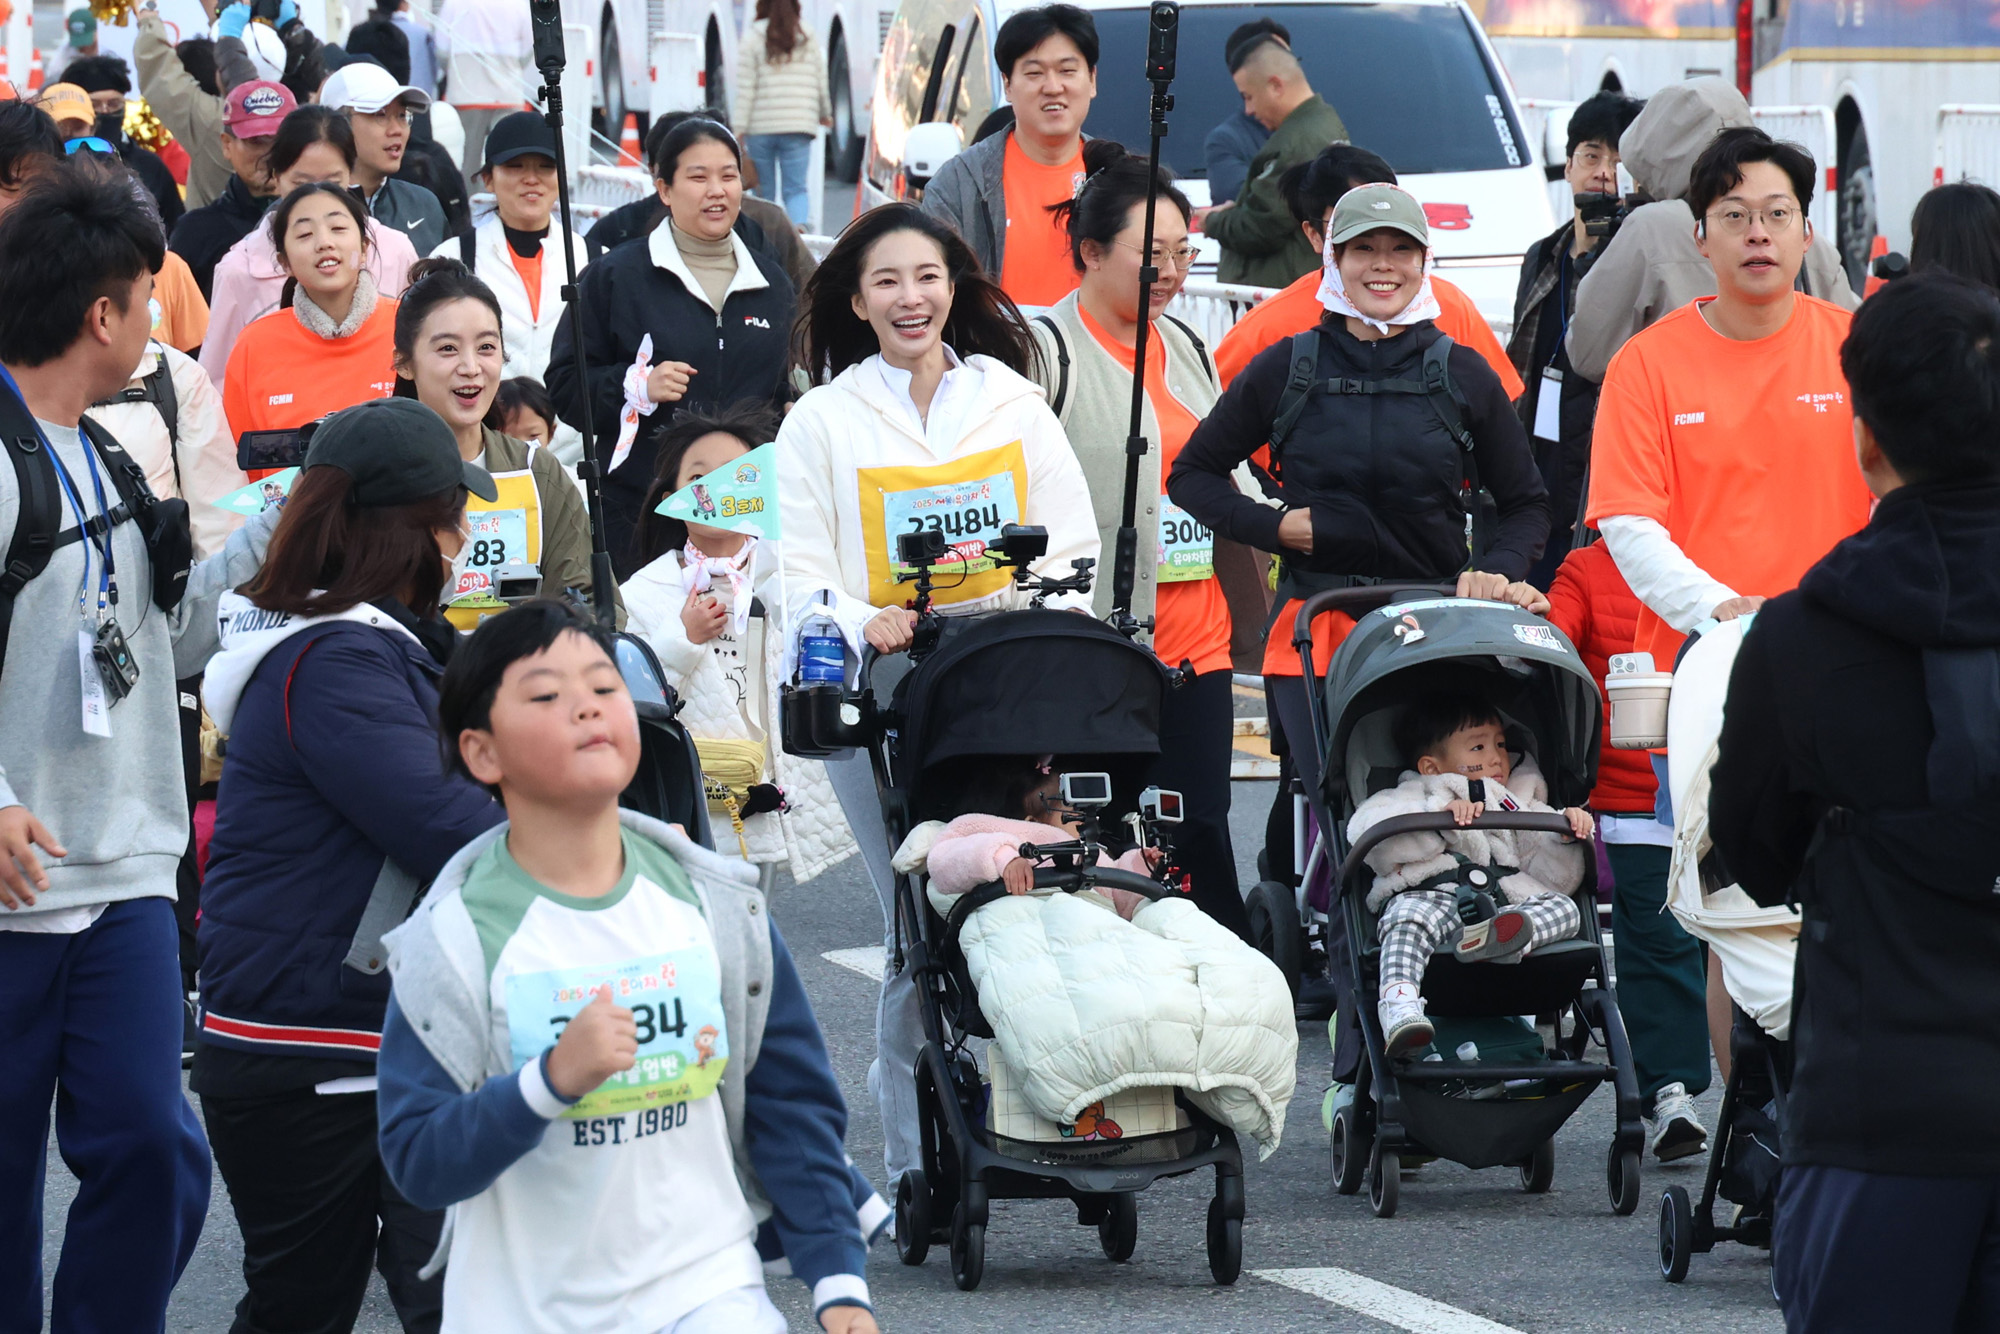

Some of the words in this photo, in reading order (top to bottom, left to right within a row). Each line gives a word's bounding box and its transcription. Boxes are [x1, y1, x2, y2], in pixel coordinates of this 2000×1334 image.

[744, 316, 771, 329] FILA
[268, 393, 293, 406] FCMM
[1796, 393, 1811, 403] 서울
[1813, 403, 1828, 413] 7K
[1674, 412, 1705, 425] FCMM
[721, 496, 764, 517] 3호차
[912, 499, 933, 509] 2025
[466, 539, 506, 567] 83
[552, 988, 584, 1002] 2025
[635, 1101, 688, 1139] 1980
